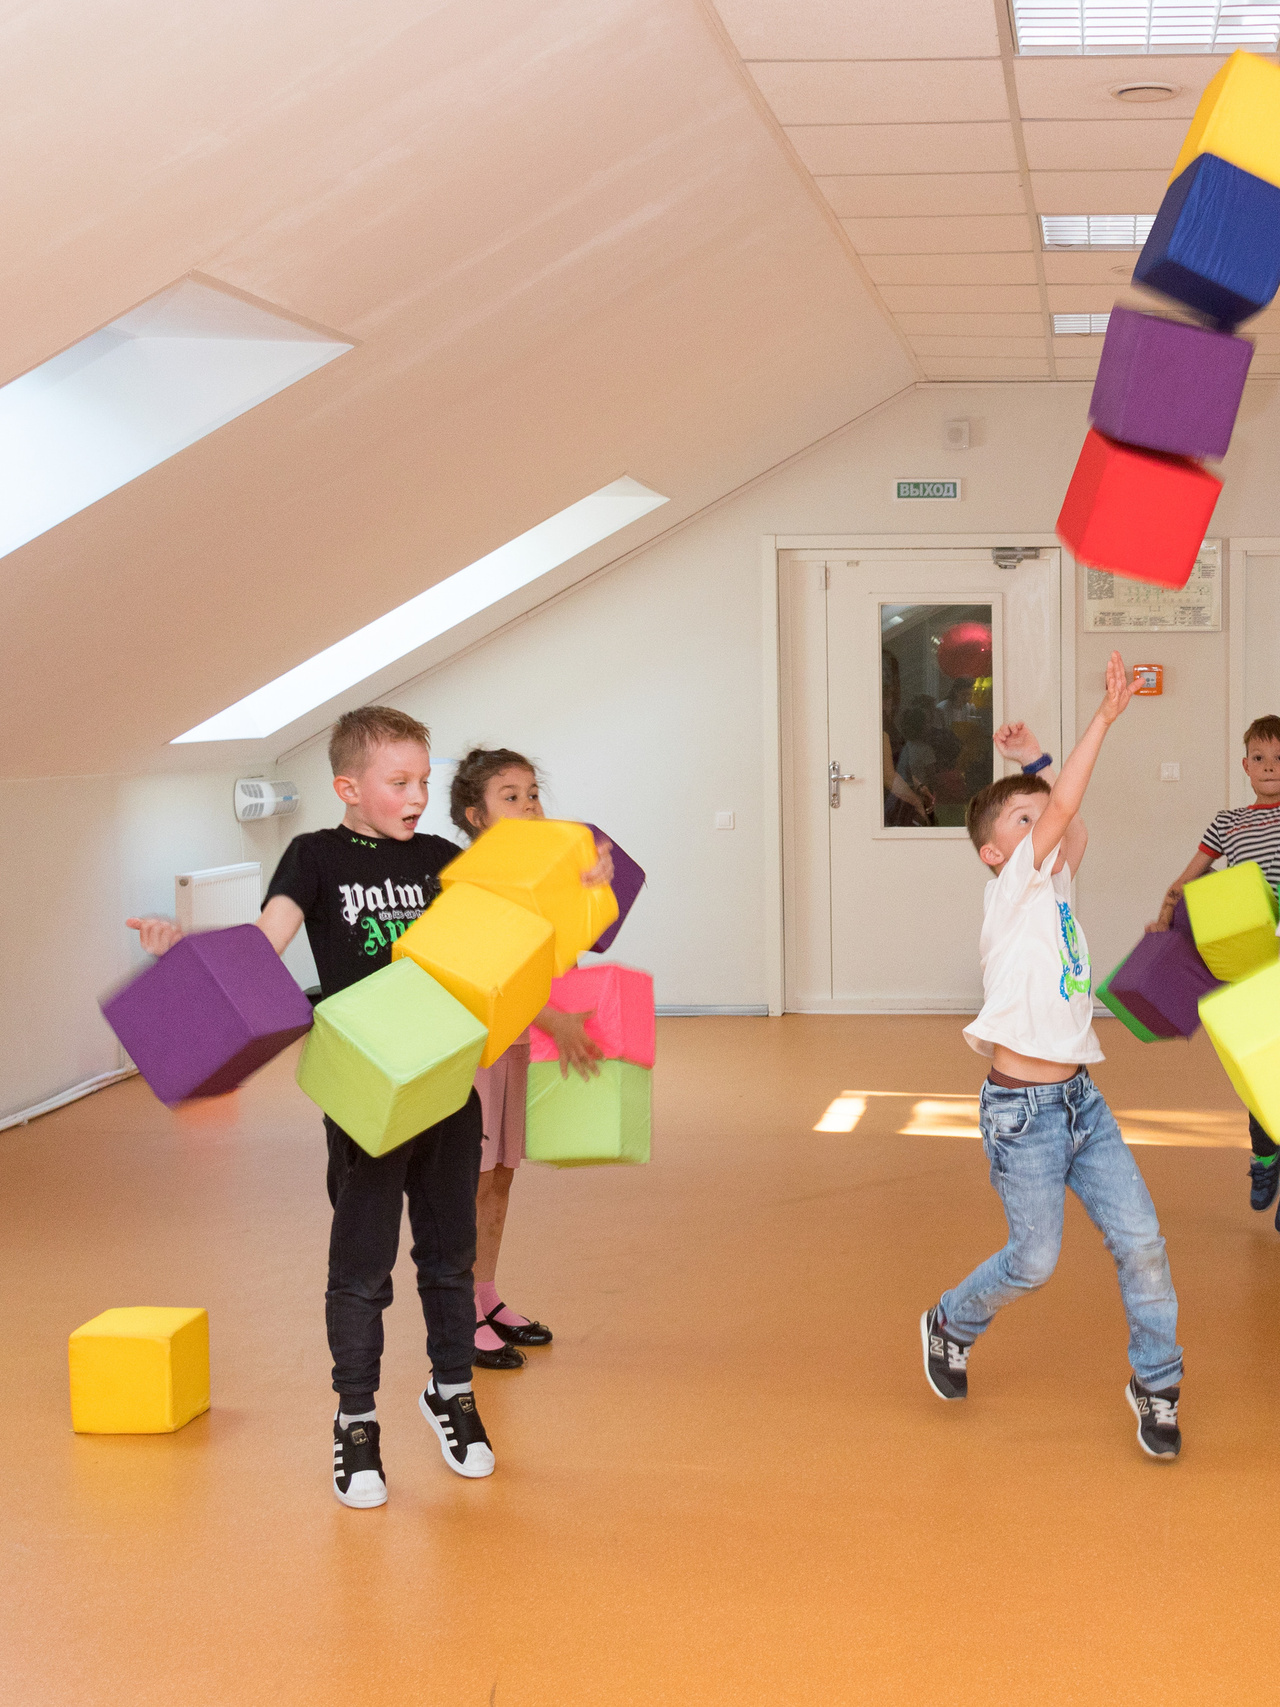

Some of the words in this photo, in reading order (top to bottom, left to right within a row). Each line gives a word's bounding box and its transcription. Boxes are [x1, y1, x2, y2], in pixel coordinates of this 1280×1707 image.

[899, 483, 955, 497] ВЫХОД
[339, 877, 427, 926] Palm
[361, 916, 416, 956] An
